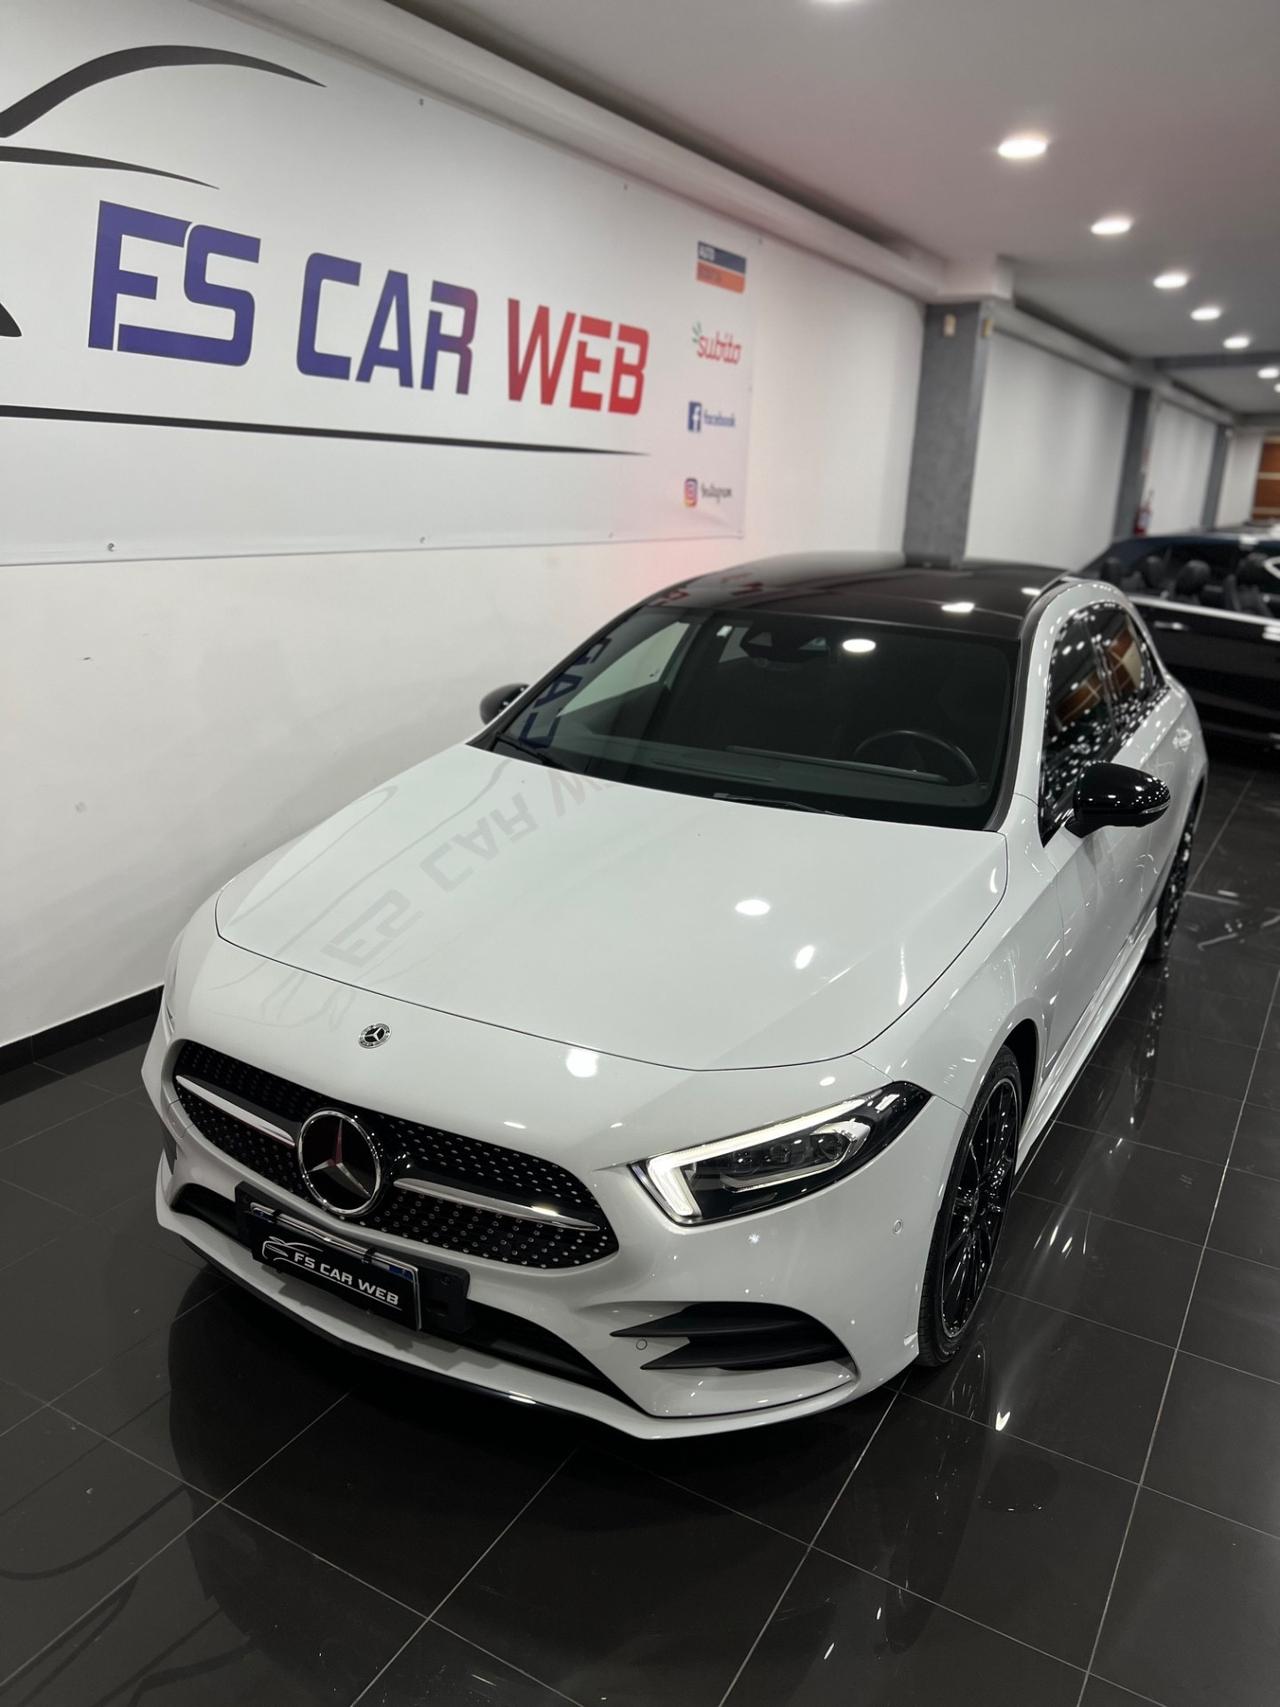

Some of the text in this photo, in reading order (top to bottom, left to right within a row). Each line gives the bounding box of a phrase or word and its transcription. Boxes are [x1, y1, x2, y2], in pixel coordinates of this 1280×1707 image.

[296, 252, 478, 395] CAR
[507, 297, 650, 416] WEB
[697, 330, 741, 365] subito
[294, 1252, 400, 1306] FS CAR WEB
